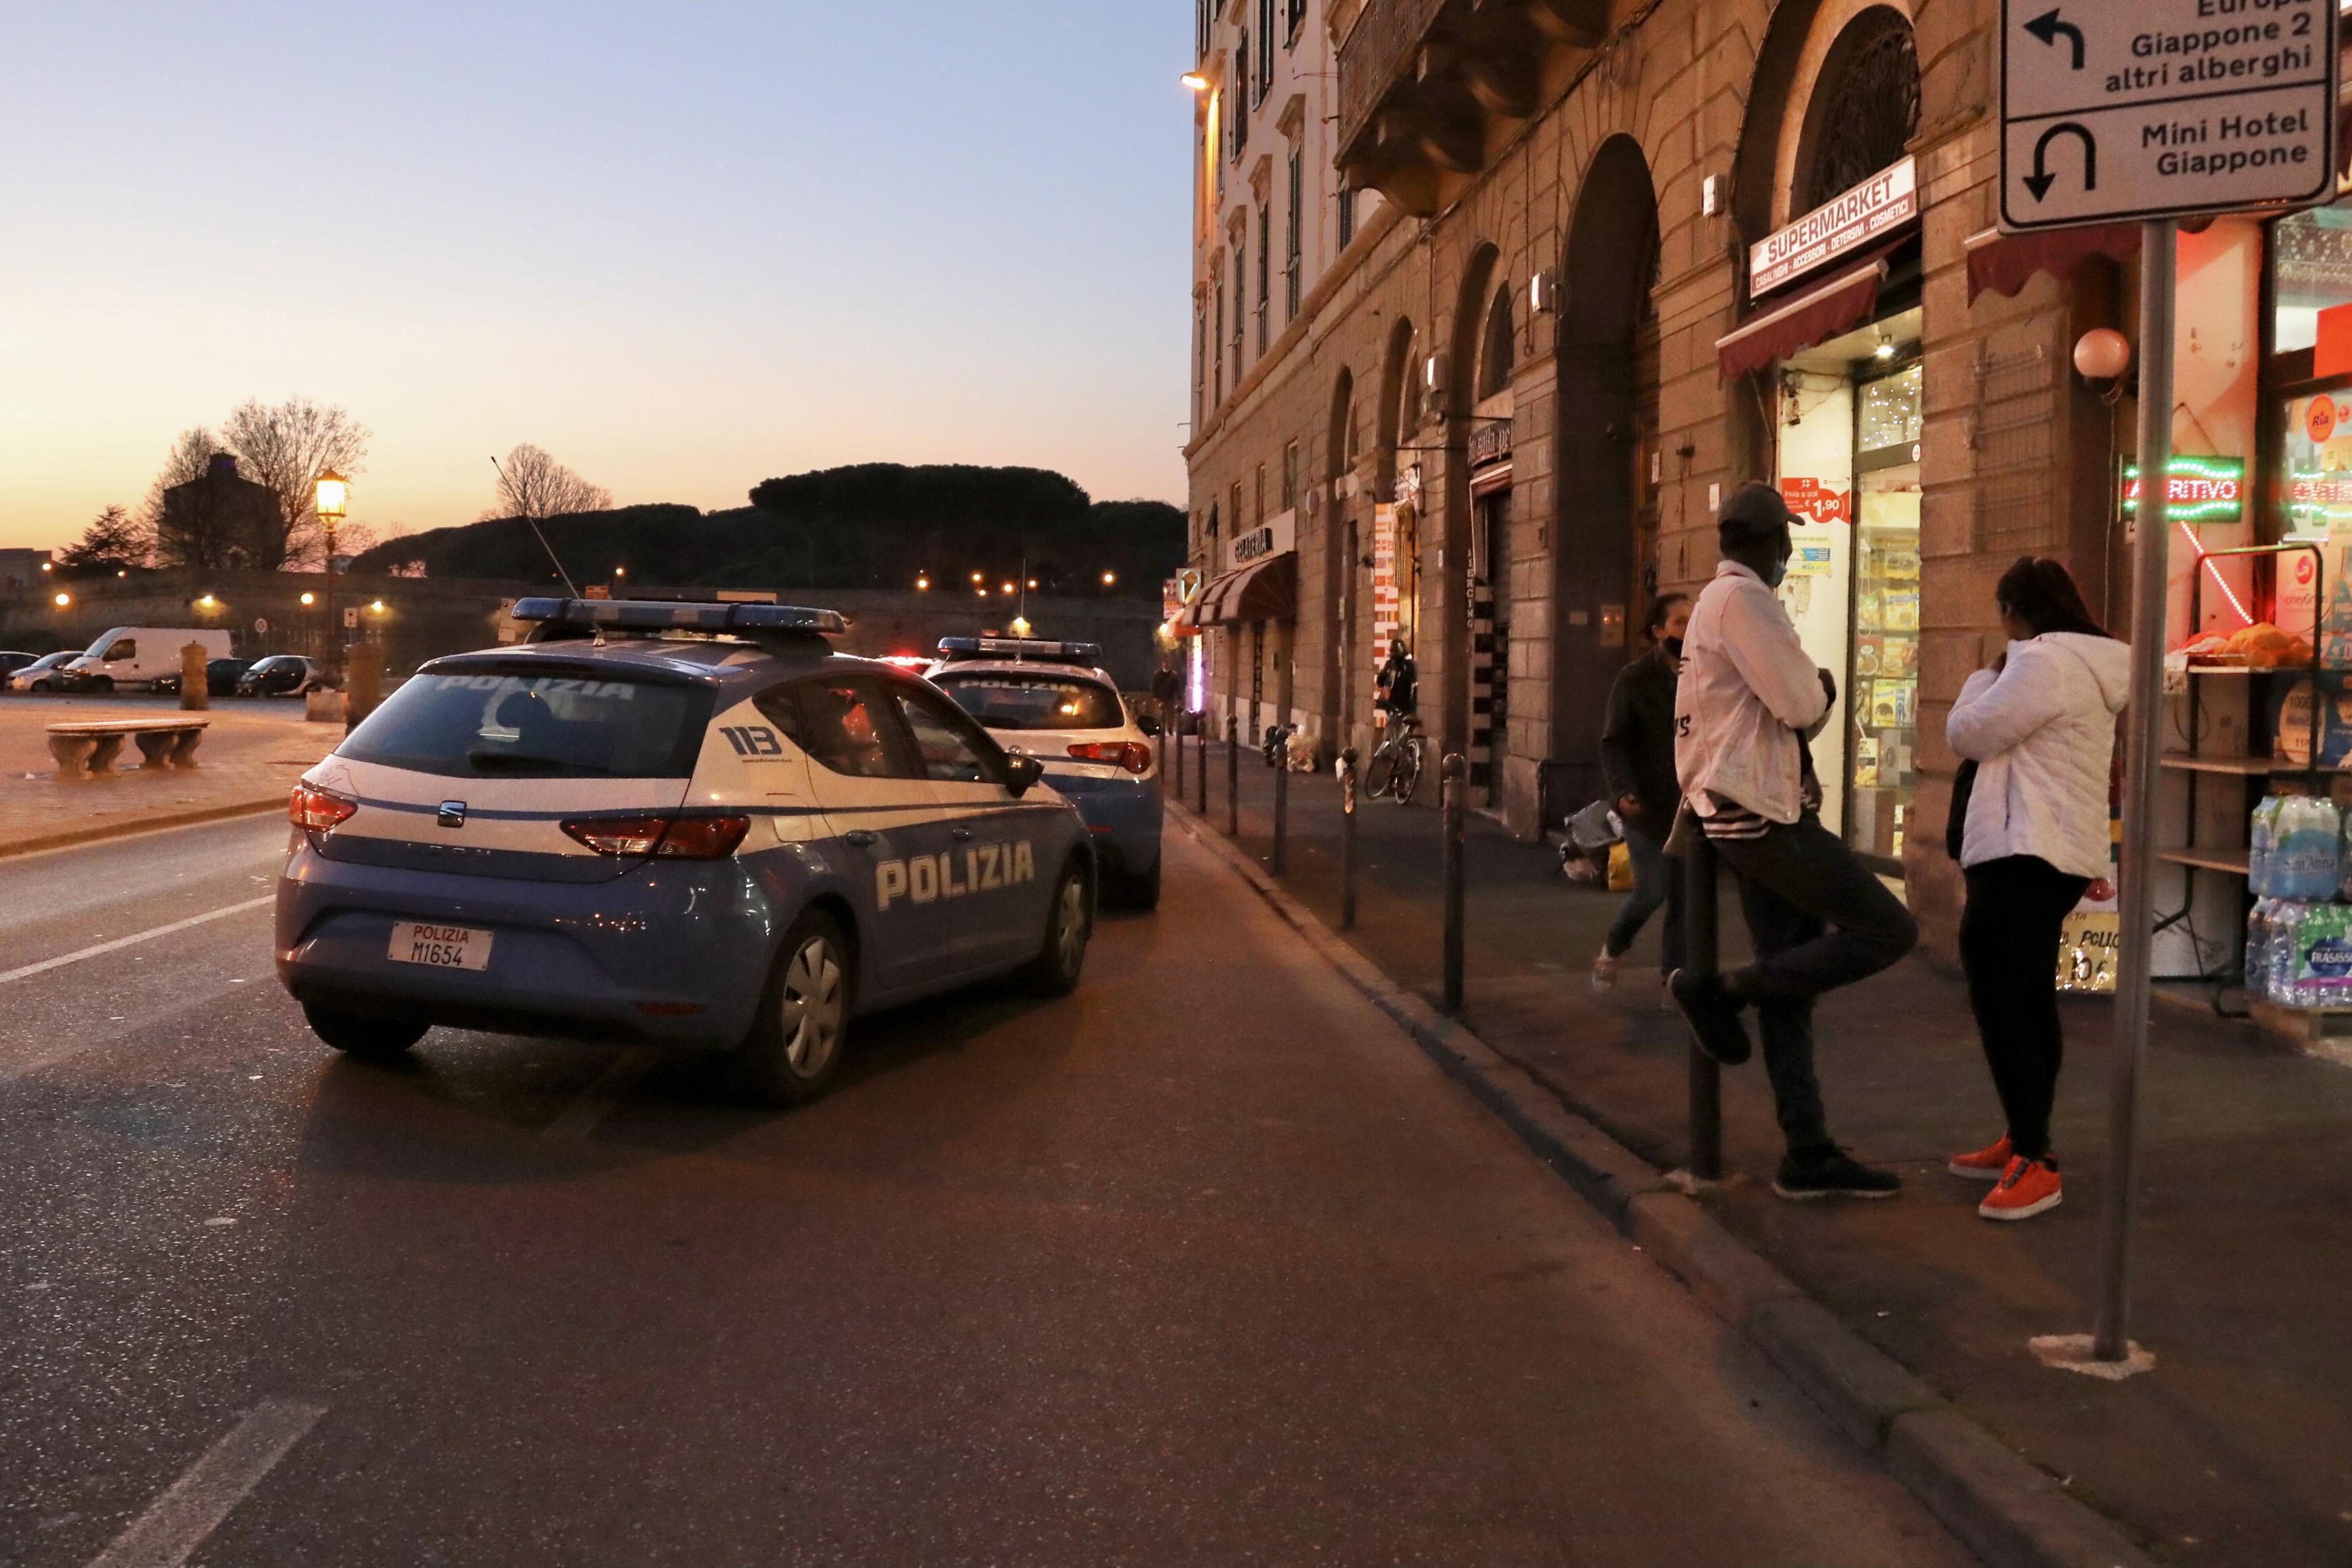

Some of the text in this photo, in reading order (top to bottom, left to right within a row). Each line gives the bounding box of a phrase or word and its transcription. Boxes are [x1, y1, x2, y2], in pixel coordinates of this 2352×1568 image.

[2132, 12, 2311, 57] Giappone 2
[2105, 44, 2311, 92] altri alberghi
[2142, 108, 2308, 148] Mini Hotel
[2157, 144, 2308, 176] Giappone
[1767, 173, 1893, 263] SUPERMARKET
[1793, 242, 1827, 271] ACCESSORI
[1831, 222, 1865, 251] DETERSIVI
[1869, 198, 1908, 230] COSMETICI
[2313, 412, 2329, 427] Ria
[1813, 499, 1840, 518] 1,90
[435, 675, 634, 701] POLIZIA
[958, 680, 1080, 693] POLIZIA
[718, 726, 782, 756] 113
[875, 840, 1035, 911] POLIZIA
[413, 925, 469, 944] POLIZIA
[411, 941, 463, 966] M1654
